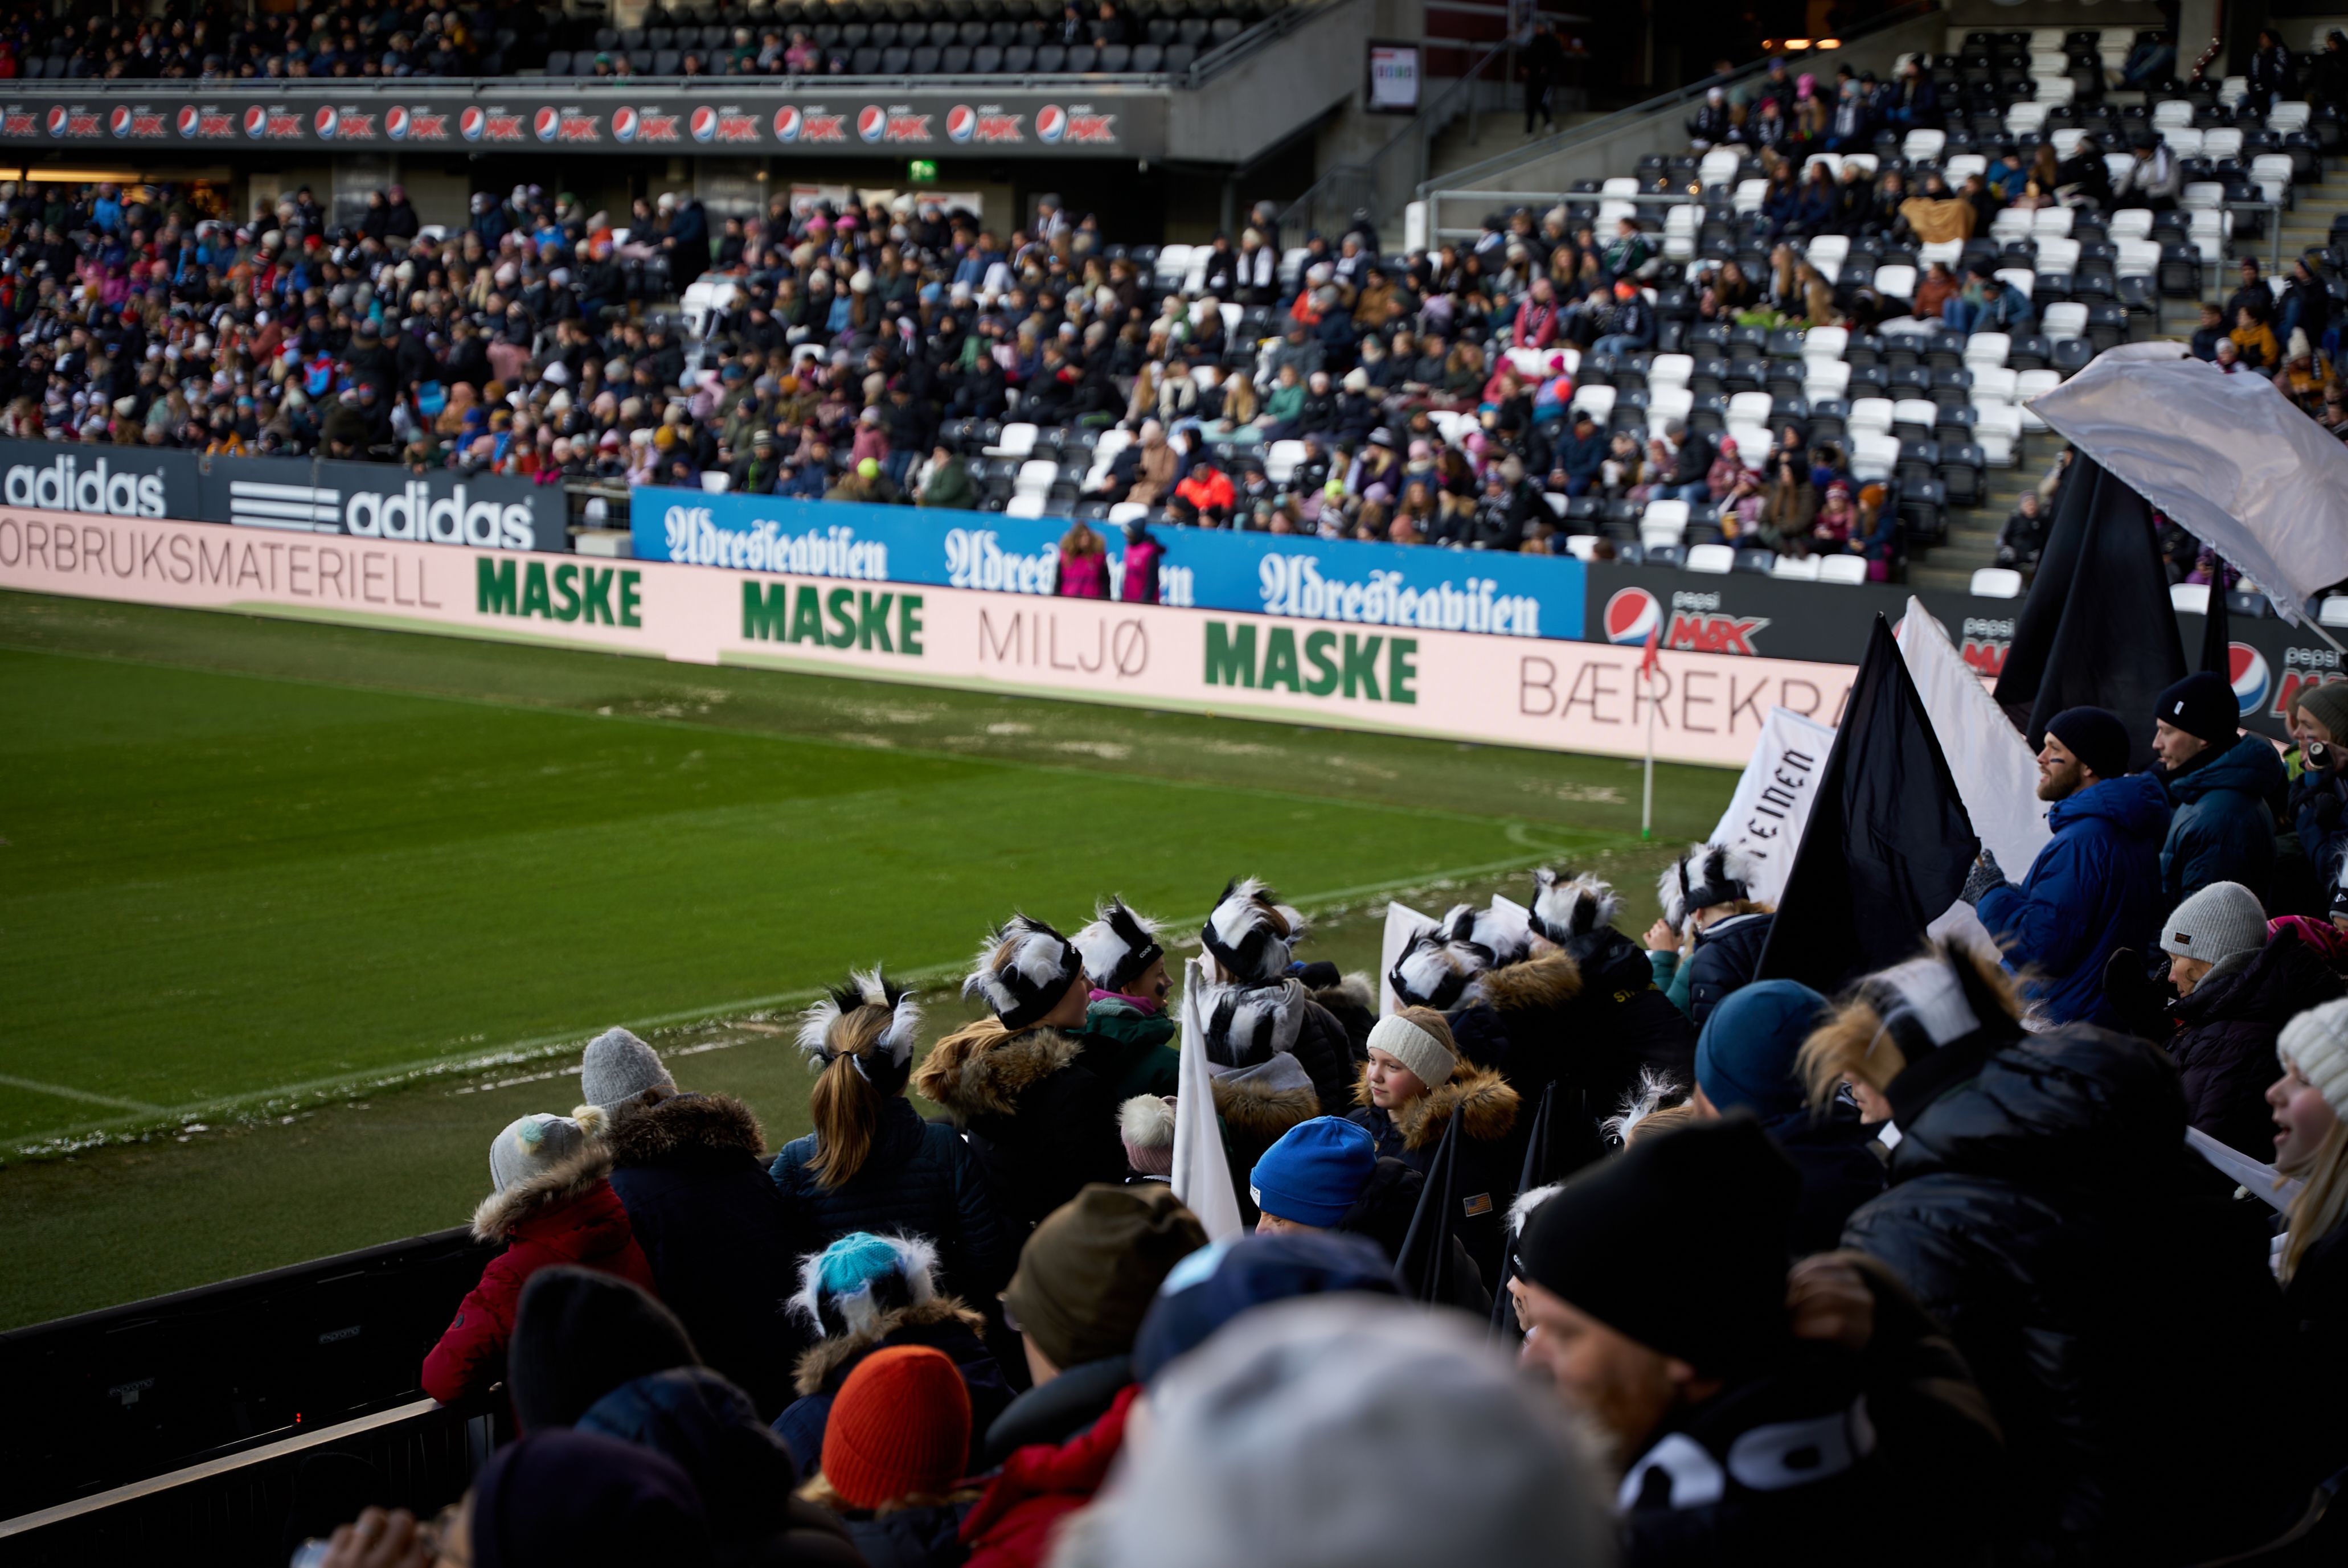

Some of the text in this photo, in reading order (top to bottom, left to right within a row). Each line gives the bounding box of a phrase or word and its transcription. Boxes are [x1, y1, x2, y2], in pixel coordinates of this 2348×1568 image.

[5, 454, 166, 519] adidas
[346, 480, 535, 551] adidas
[477, 556, 641, 628] MASKE
[1672, 590, 1720, 611] pepsi
[743, 580, 1148, 678] MASKE MILJØ
[1662, 611, 1771, 656] MAX
[1963, 617, 2015, 639] pepsi
[1205, 621, 1417, 704] MASKE
[2284, 647, 2340, 669] pepsi
[1138, 945, 1152, 958] coop
